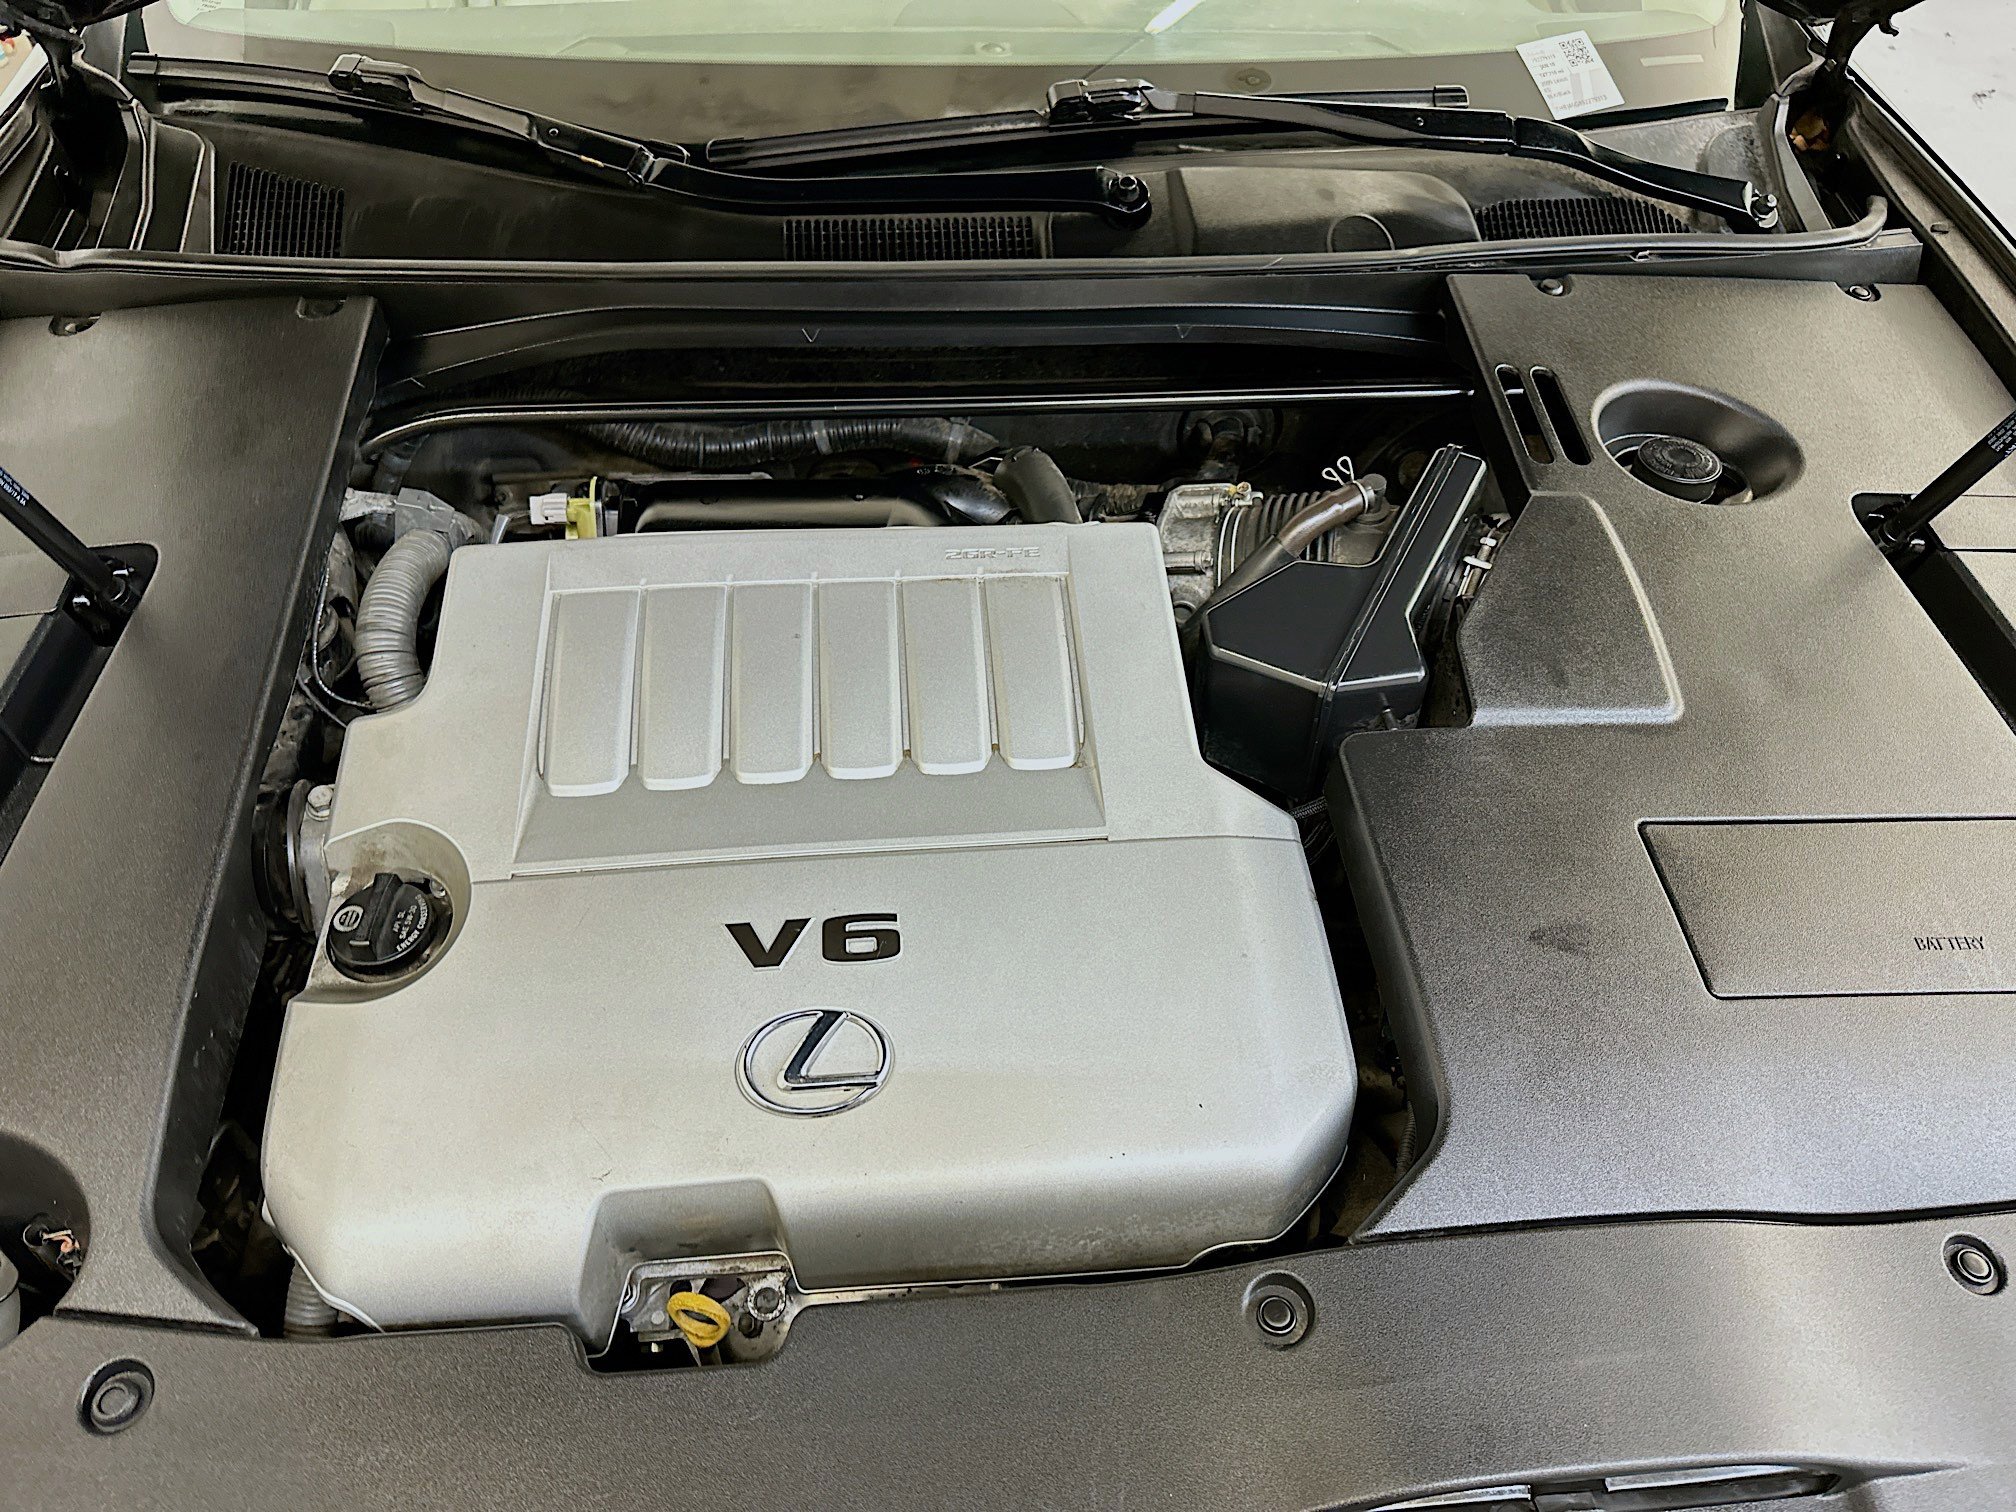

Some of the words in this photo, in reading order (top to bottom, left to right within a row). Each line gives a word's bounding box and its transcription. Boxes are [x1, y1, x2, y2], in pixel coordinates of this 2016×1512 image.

[944, 546, 1041, 560] 2GR-FE
[396, 930, 420, 952] ENERGY
[724, 912, 902, 970] V6
[1914, 936, 1985, 951] BATTERY
